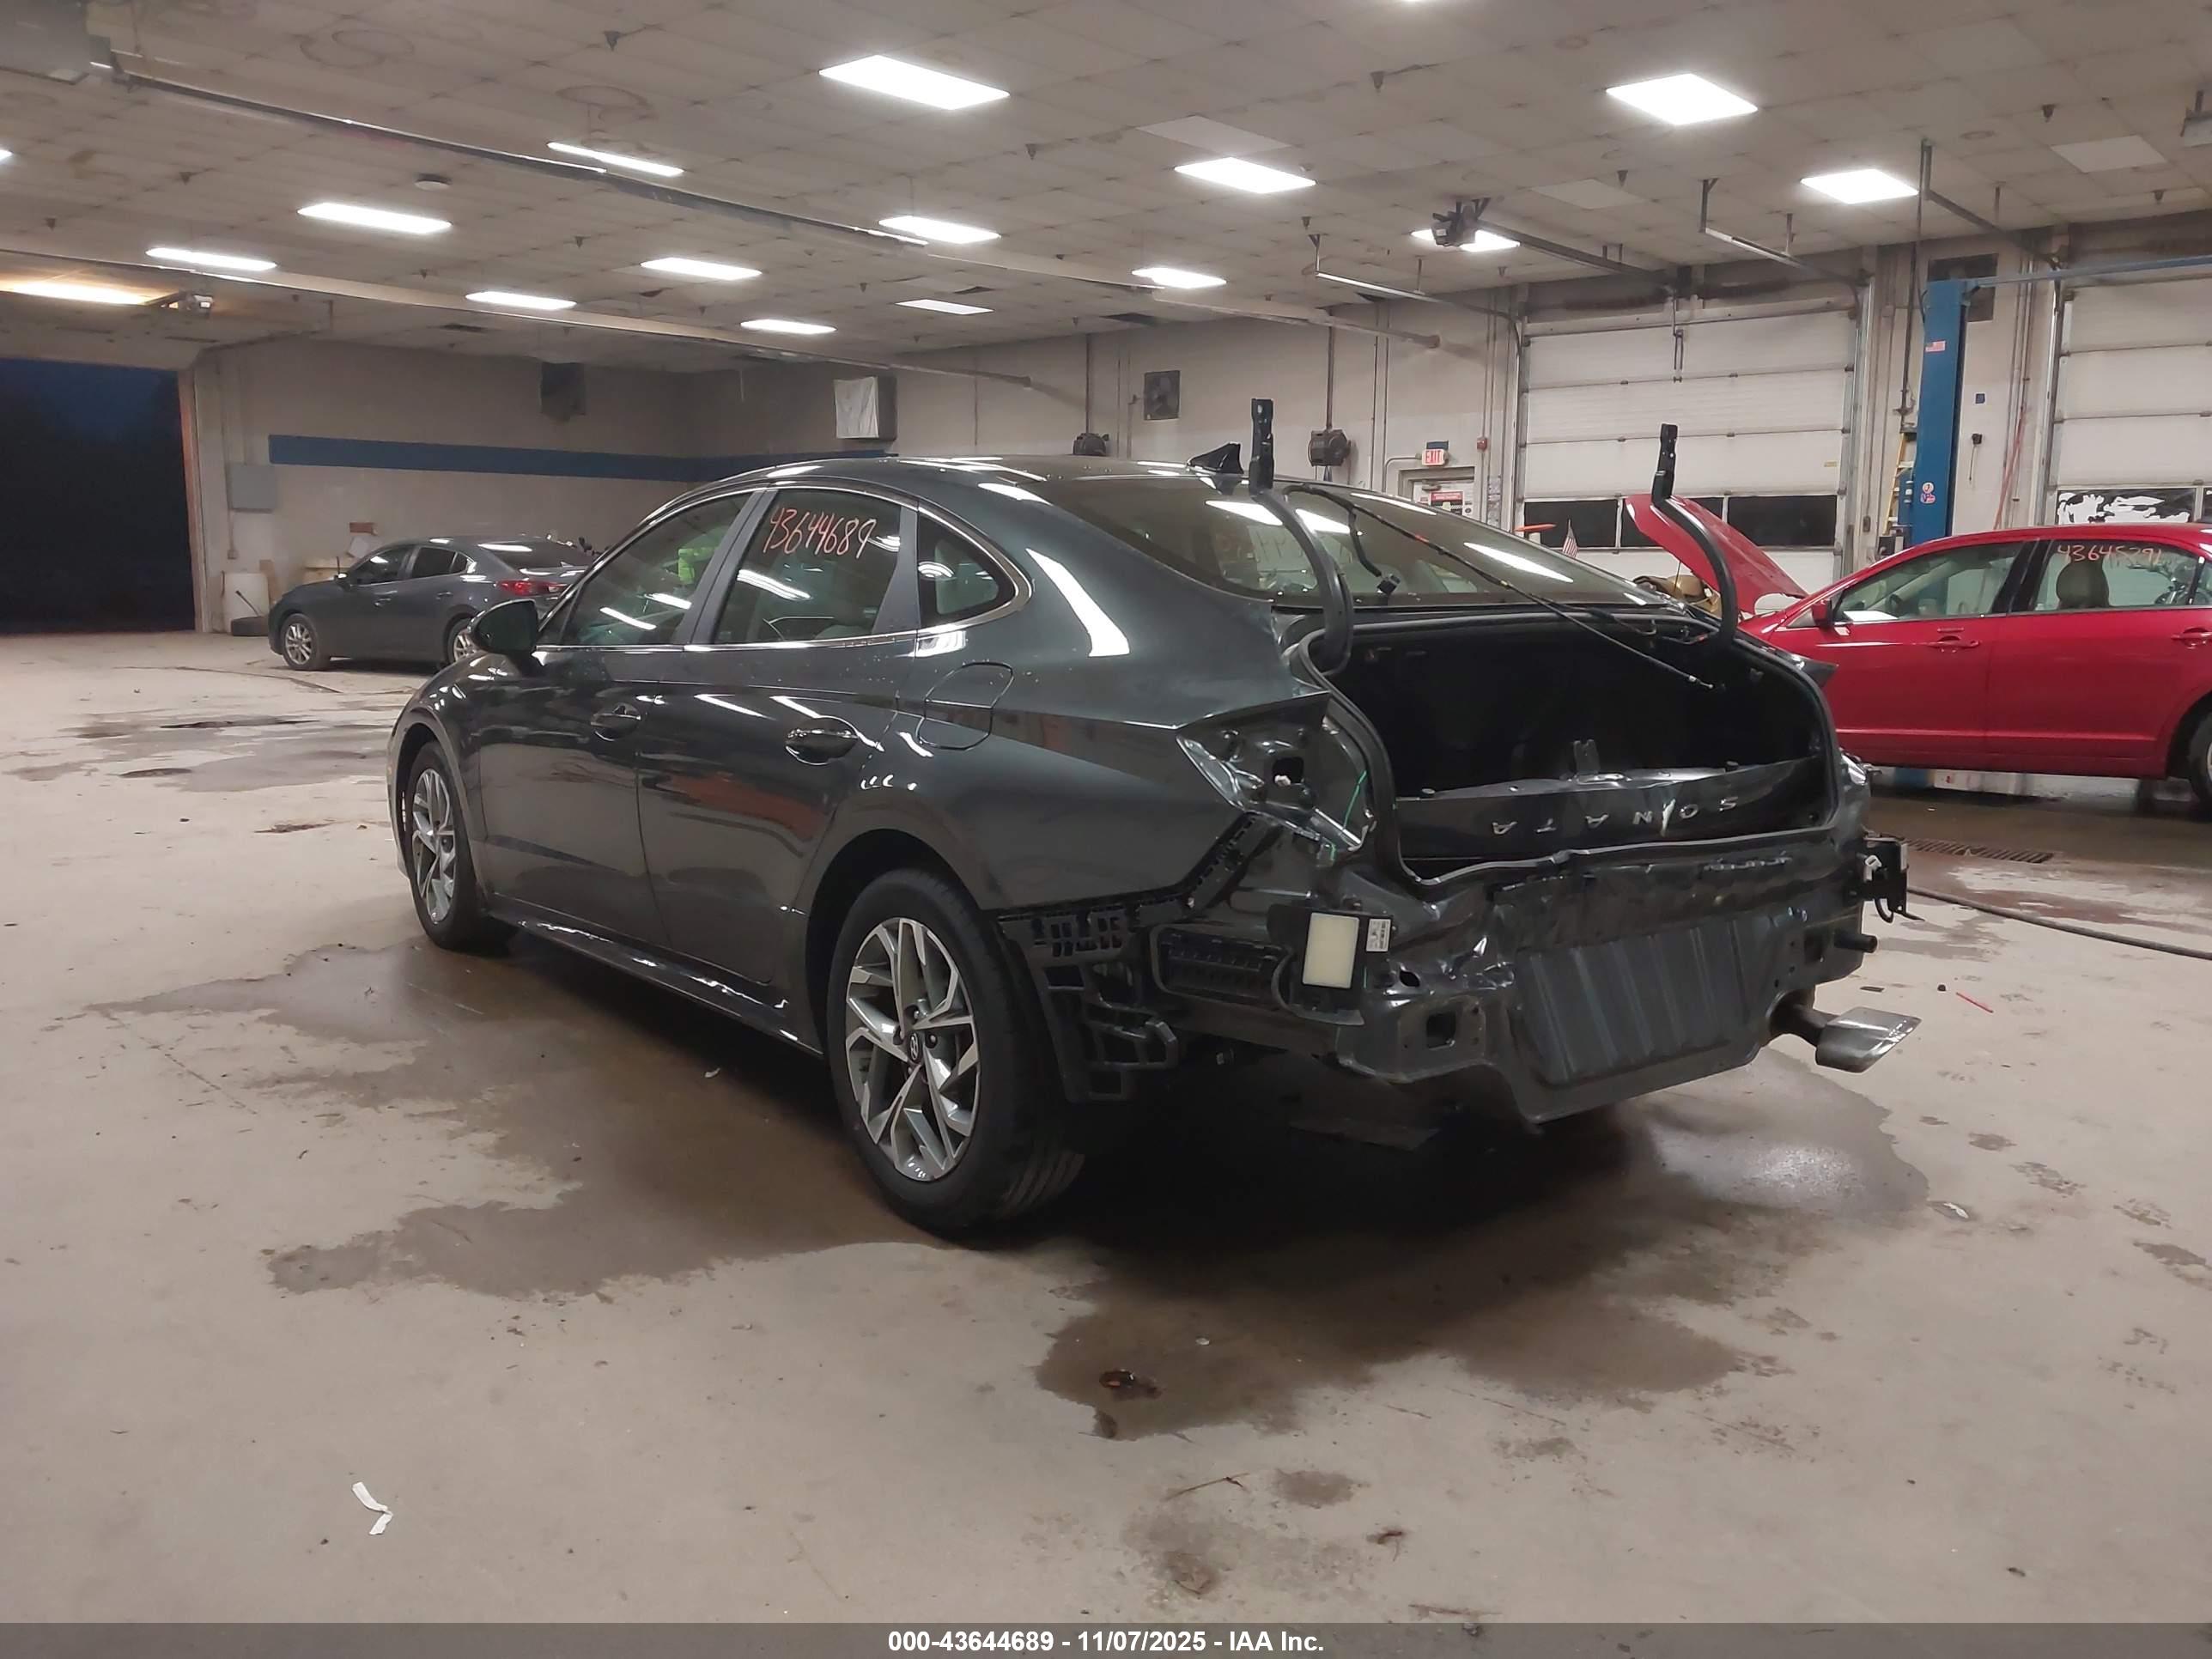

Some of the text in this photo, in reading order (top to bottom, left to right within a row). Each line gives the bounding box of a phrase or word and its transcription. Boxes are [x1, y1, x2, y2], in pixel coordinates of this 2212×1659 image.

[1425, 450, 1442, 464] EXIT
[763, 507, 878, 560] 43644689
[1491, 795, 1740, 836] SONATA
